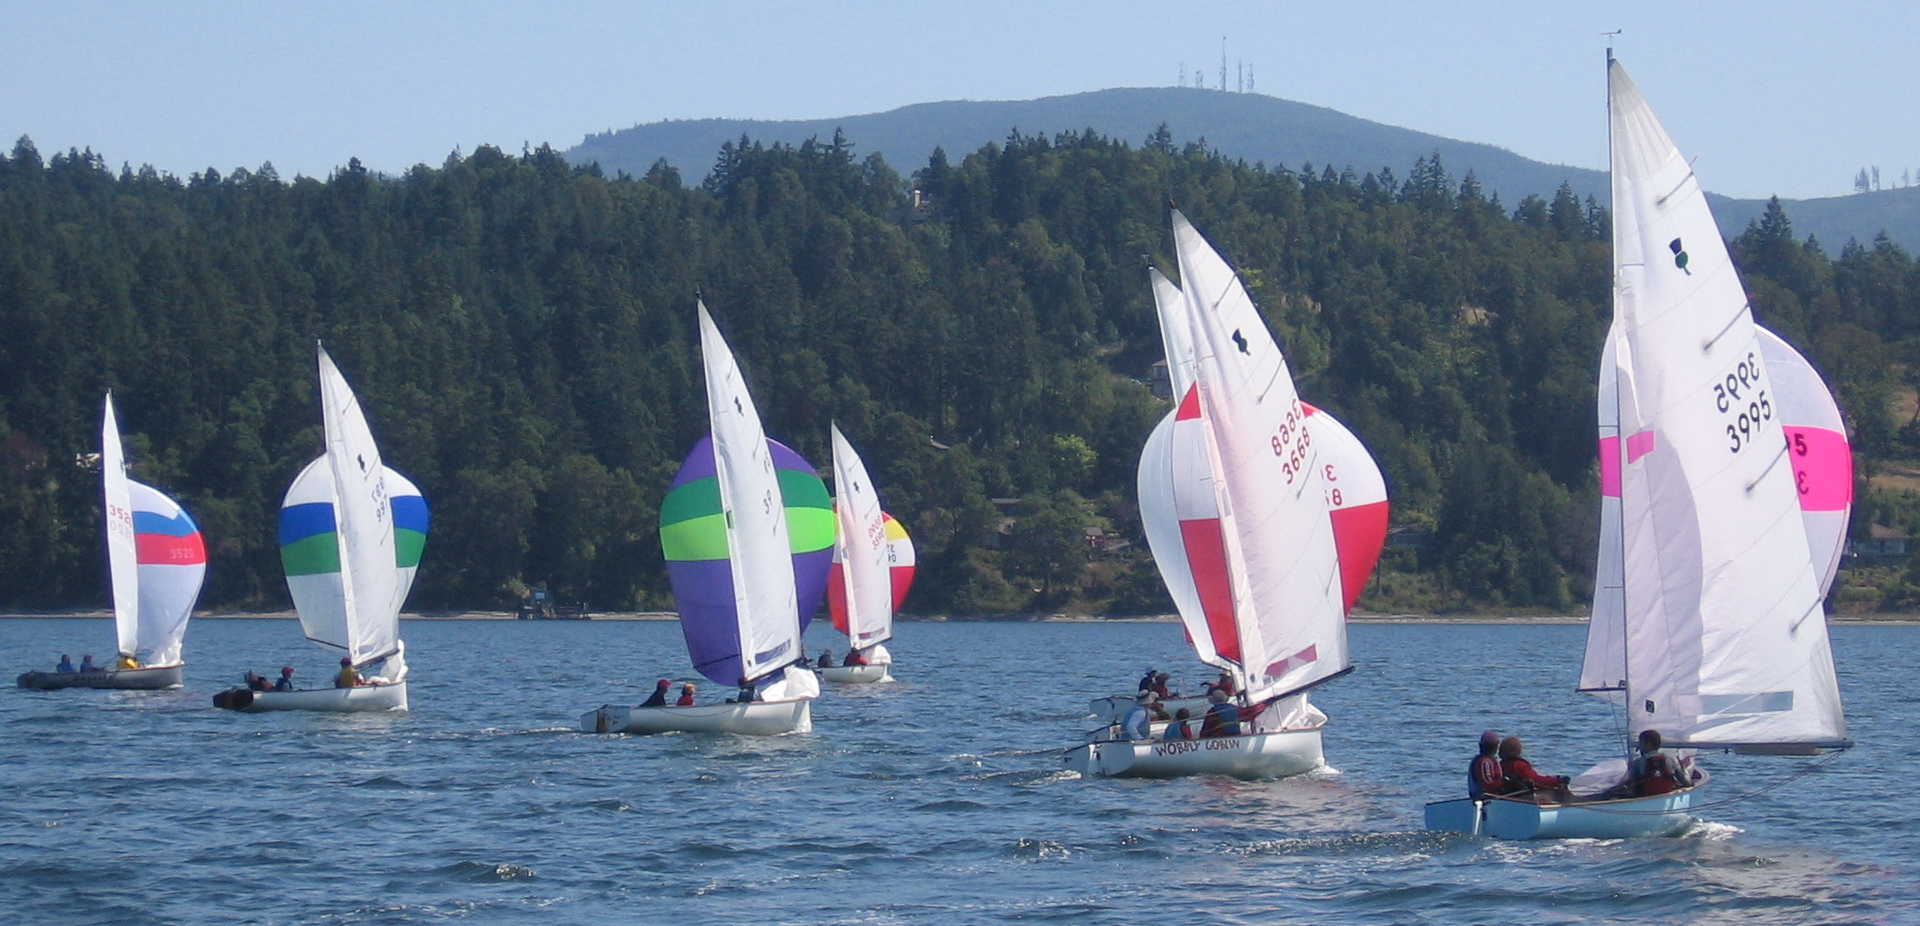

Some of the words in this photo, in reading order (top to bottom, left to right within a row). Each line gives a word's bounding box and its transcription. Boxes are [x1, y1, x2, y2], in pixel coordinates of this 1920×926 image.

[1727, 390, 1771, 453] 3995
[1281, 426, 1310, 484] 3668
[109, 505, 131, 526] 352
[170, 548, 199, 559] 3520
[1155, 741, 1200, 756] WOBBLY
